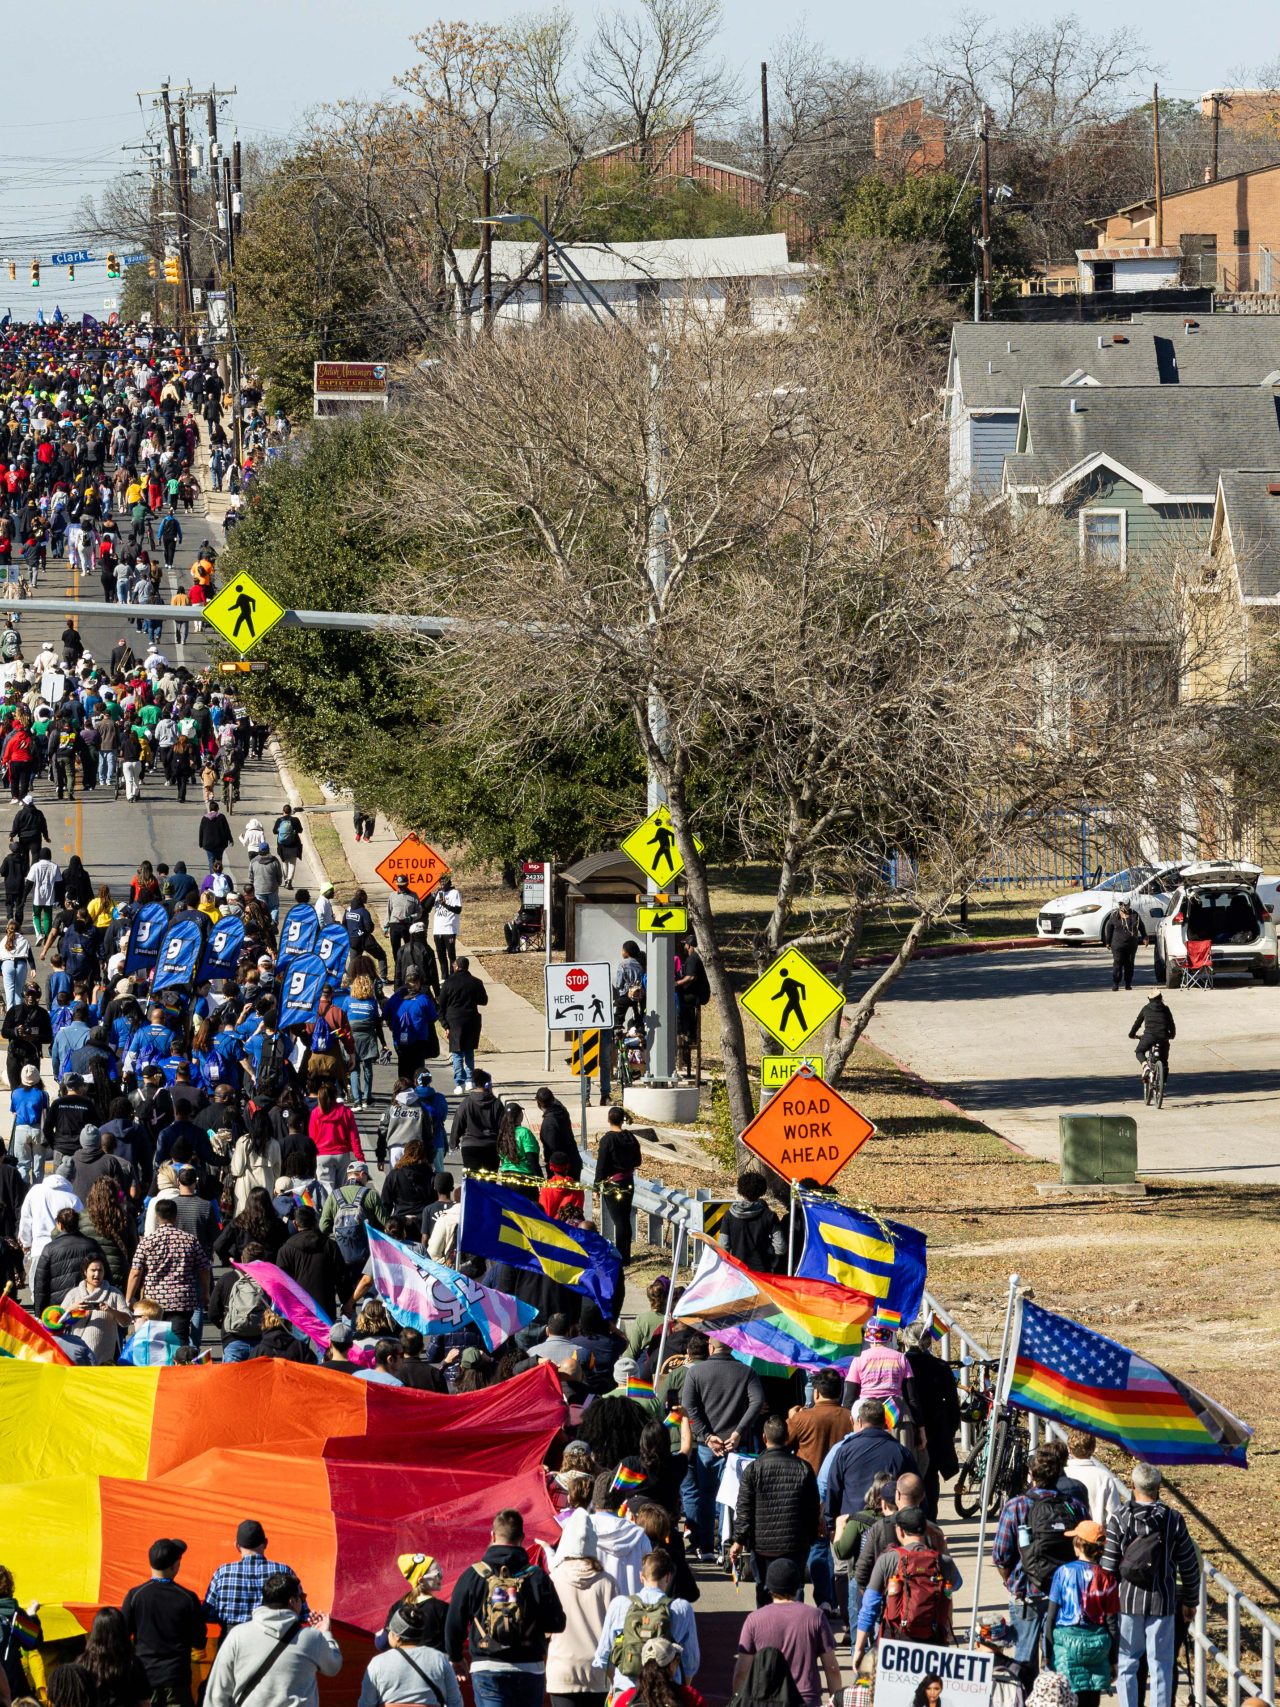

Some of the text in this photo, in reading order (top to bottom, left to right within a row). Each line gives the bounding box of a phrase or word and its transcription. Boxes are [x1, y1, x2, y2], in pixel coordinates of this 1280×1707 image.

[57, 251, 85, 262] Clark
[388, 858, 436, 869] DETOUR
[392, 873, 433, 884] AEAD
[566, 975, 588, 985] STOP
[554, 994, 576, 1004] HERE
[574, 1013, 584, 1022] TO
[770, 1065, 797, 1079] AHE
[783, 1098, 830, 1117] ROAD
[783, 1121, 833, 1140] WORK
[780, 1145, 839, 1164] AHEAD
[881, 1644, 991, 1683] CROCKETT
[881, 1671, 988, 1695] TEXAS TOUGH
